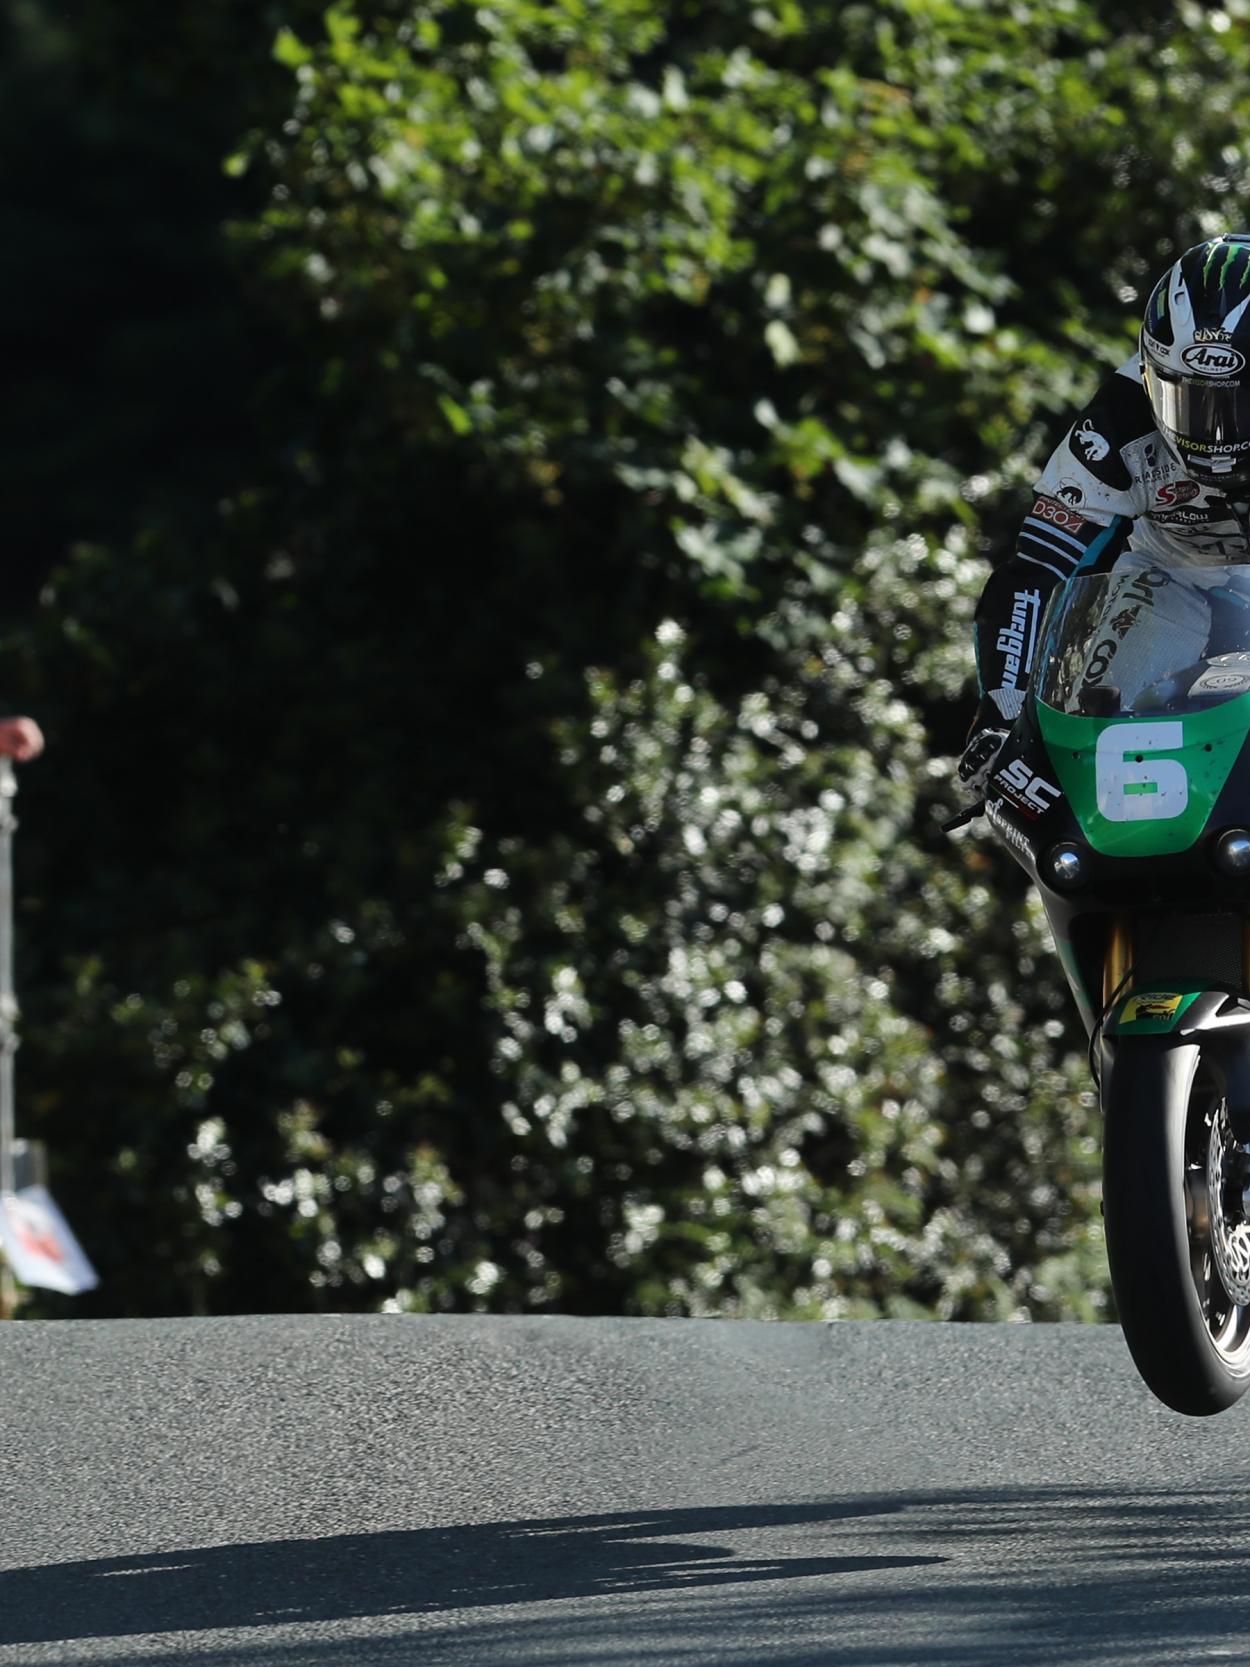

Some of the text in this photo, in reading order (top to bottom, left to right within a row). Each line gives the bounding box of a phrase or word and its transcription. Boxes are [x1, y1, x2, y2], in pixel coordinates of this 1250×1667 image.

[1186, 347, 1236, 368] Arai
[994, 774, 1044, 814] PROJECT
[1000, 759, 1062, 810] SC
[1096, 721, 1188, 822] 6
